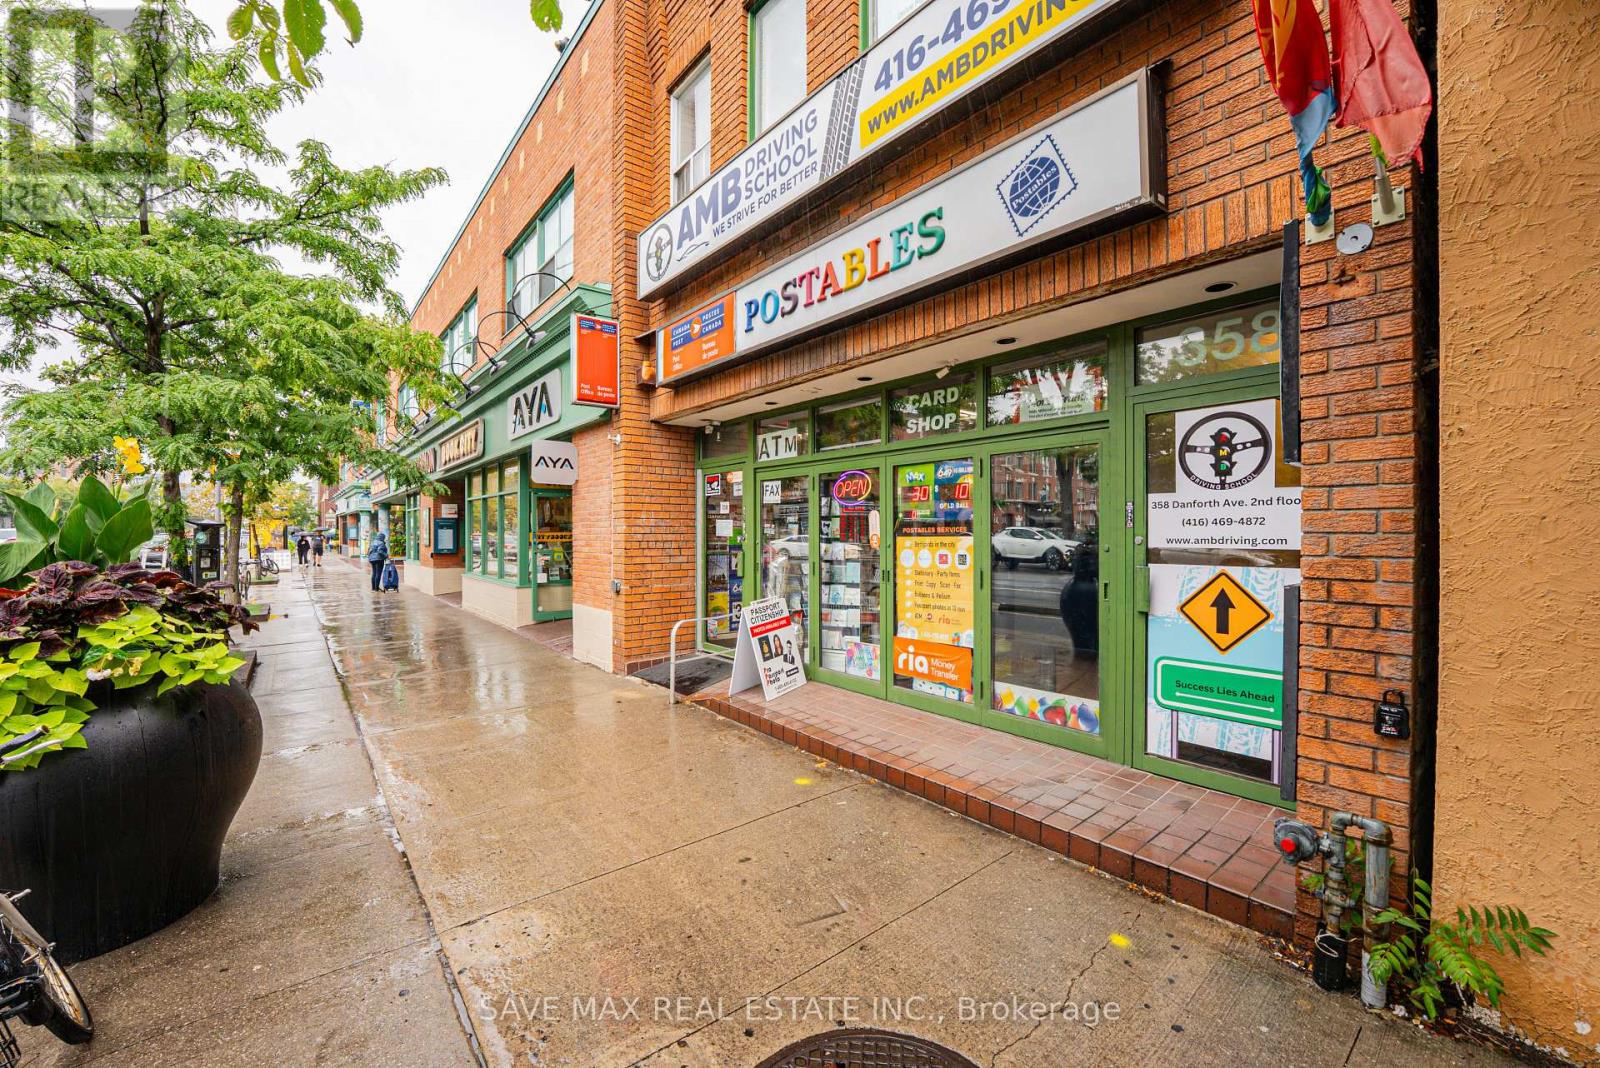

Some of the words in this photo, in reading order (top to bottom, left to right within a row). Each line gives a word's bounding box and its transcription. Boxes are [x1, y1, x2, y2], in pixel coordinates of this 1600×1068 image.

[745, 109, 818, 178] DRIVING
[744, 136, 818, 200] SCHOOL
[1012, 166, 1057, 210] Postables
[677, 167, 742, 250] AMB
[712, 222, 726, 239] WE
[727, 202, 756, 230] STRIVE
[758, 189, 777, 210] FOR
[780, 161, 818, 197] BETTER
[744, 206, 946, 333] POSTABLES
[673, 323, 690, 336] CANADA
[702, 320, 722, 334] CANADA
[1176, 309, 1282, 367] 358
[909, 387, 959, 408] CARD
[512, 381, 553, 434] AYA
[906, 412, 957, 434] SHOP
[759, 434, 797, 460] ATM
[535, 456, 574, 470] AYA
[834, 479, 868, 498] OPEN
[1189, 474, 1221, 490] DRIVING
[1225, 472, 1258, 489] SCHOOL
[764, 484, 780, 497] FAX
[912, 486, 929, 501] 30
[955, 483, 969, 499] 10
[1151, 500, 1170, 509] 358
[1172, 499, 1220, 509] Danforth
[1223, 498, 1248, 508] Ave.
[1251, 496, 1273, 507] 2nd
[1181, 517, 1209, 527] (416)
[1211, 516, 1266, 527] 469-4872
[1165, 535, 1288, 547] www.ambdriving.com
[751, 602, 780, 615] PASSPORT
[751, 609, 783, 625] CITIZENSHIP
[898, 644, 928, 674] ria
[930, 657, 956, 672] Money
[931, 667, 960, 681] Transfer
[1175, 680, 1214, 693] Success
[1217, 686, 1237, 697] Lies
[1240, 690, 1275, 703] Ahead
